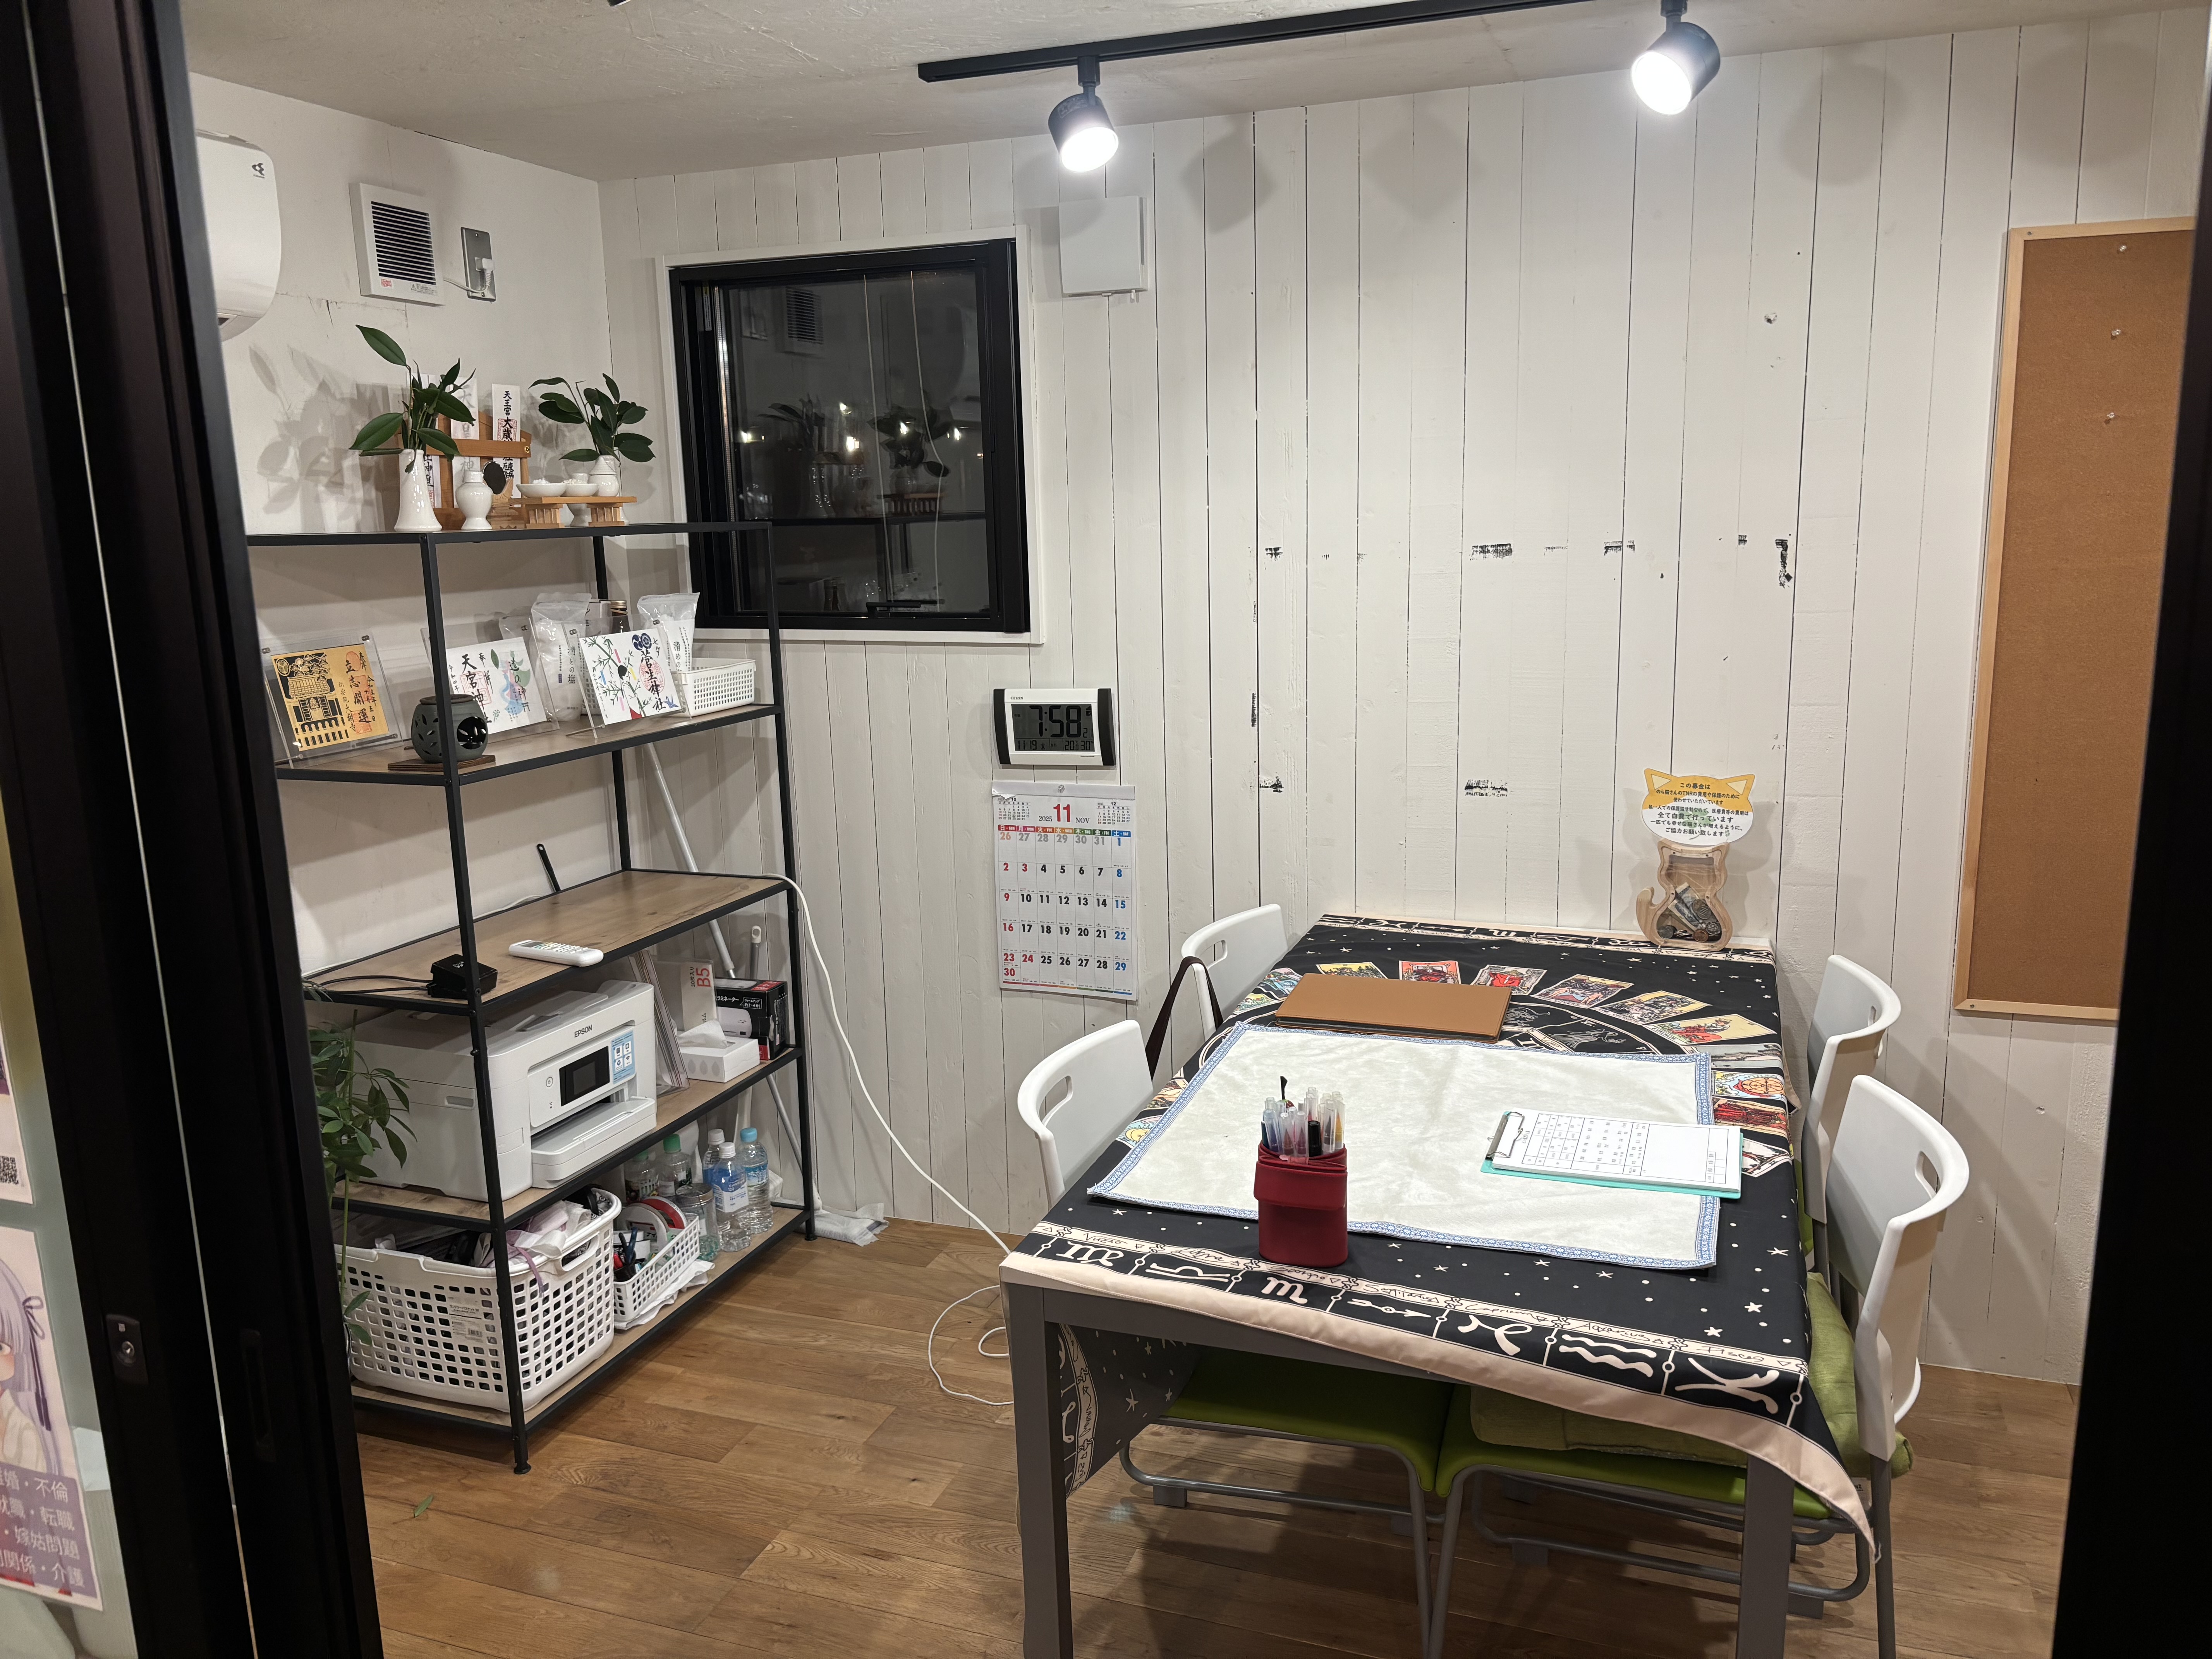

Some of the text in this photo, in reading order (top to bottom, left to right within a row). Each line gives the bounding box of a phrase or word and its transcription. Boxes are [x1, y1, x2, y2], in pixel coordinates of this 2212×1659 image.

[501, 391, 514, 461] 天王宮大歳
[673, 641, 682, 672] 清めの
[345, 660, 372, 723] 立志開運
[1029, 705, 1081, 738] 7:58
[1656, 790, 1740, 799] のら猫さんのTNRの費用や保護のために
[1053, 804, 1071, 823] 11
[1657, 812, 1733, 823] 全て自費で行っています
[1000, 832, 1121, 846] 26 27 28 29 30 31 1
[1666, 828, 1723, 836] ご協力お願い致します
[1003, 862, 1122, 878] 2 3 4 5 6 7 8
[1004, 893, 1126, 909] 9 10 11 12 13 14 15
[1003, 923, 1126, 940] 16 17 18 19 20 21 22
[1003, 953, 1126, 971] 23 24 25 26 27 28 29
[696, 968, 711, 988] B5
[1004, 968, 1015, 977] 30
[574, 1024, 592, 1038] EPSON
[0, 1550, 85, 1587] 関係・介護
